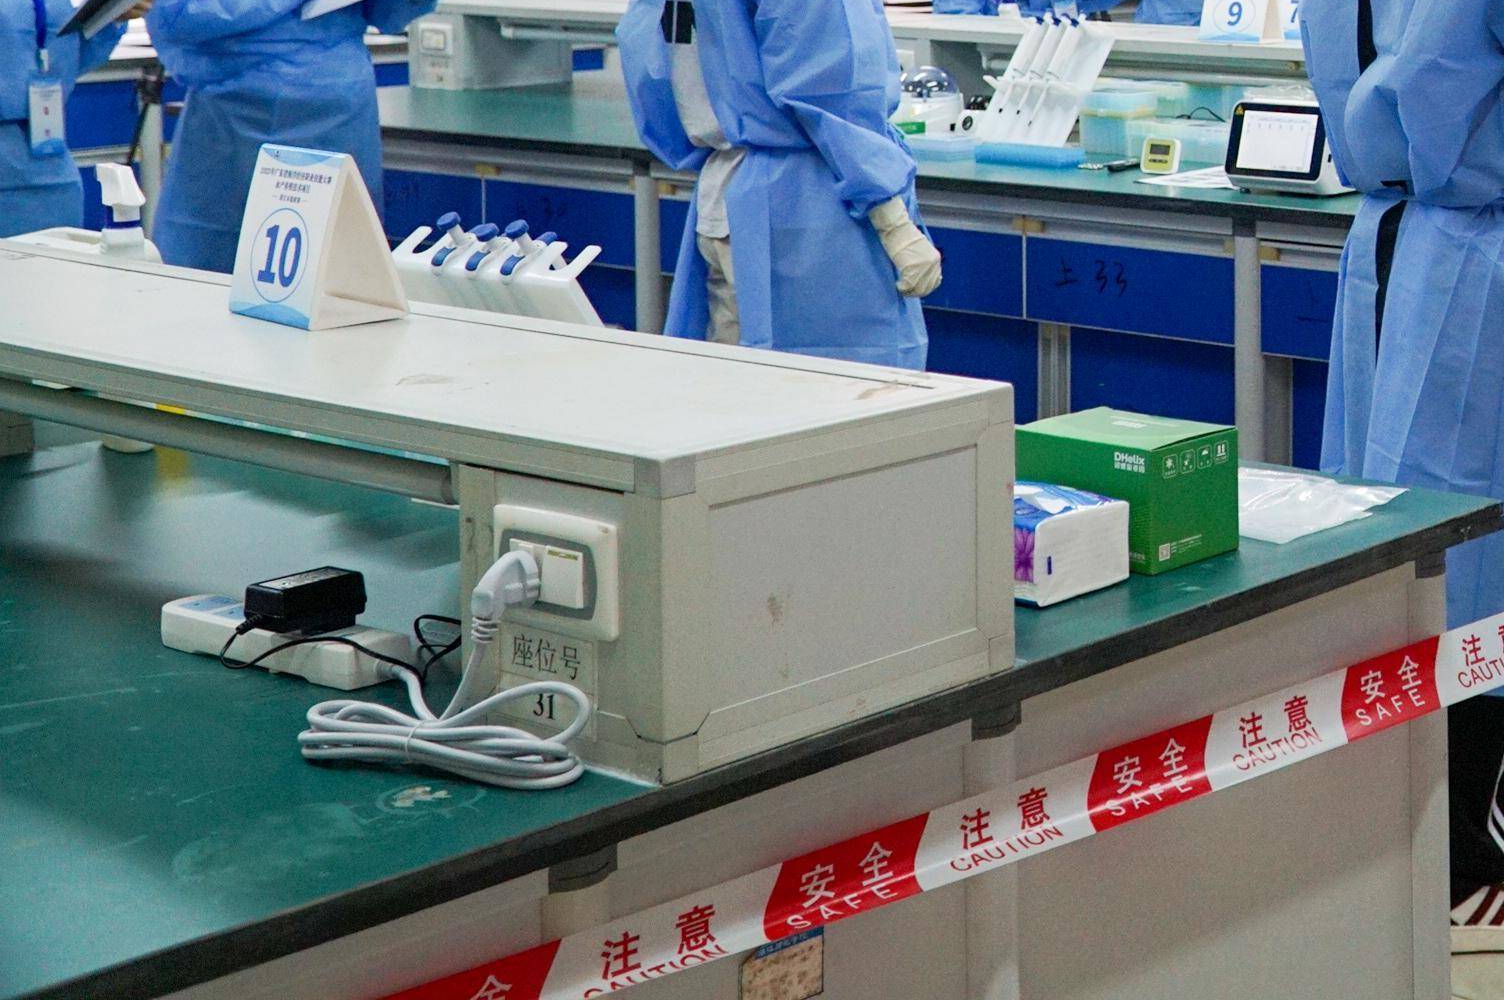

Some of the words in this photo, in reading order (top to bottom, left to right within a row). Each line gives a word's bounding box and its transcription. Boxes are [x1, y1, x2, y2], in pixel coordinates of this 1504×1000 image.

[1227, 1, 1243, 26] 9
[1290, 0, 1300, 23] 7
[257, 224, 302, 288] 10
[1113, 451, 1145, 465] DHelix
[511, 633, 581, 681] 座位号
[1360, 655, 1423, 704] 安全
[532, 692, 556, 721] 31
[1238, 695, 1312, 749] 注意
[1356, 688, 1427, 728] SAFE
[1112, 737, 1188, 795] 安全
[1232, 727, 1324, 773] CAUTION
[959, 786, 1050, 850] 注意
[1105, 774, 1195, 817] SAFE
[950, 825, 1064, 872] CAUTION
[800, 841, 894, 908] 安全
[786, 881, 898, 930] SAFE
[601, 903, 715, 980] 注意
